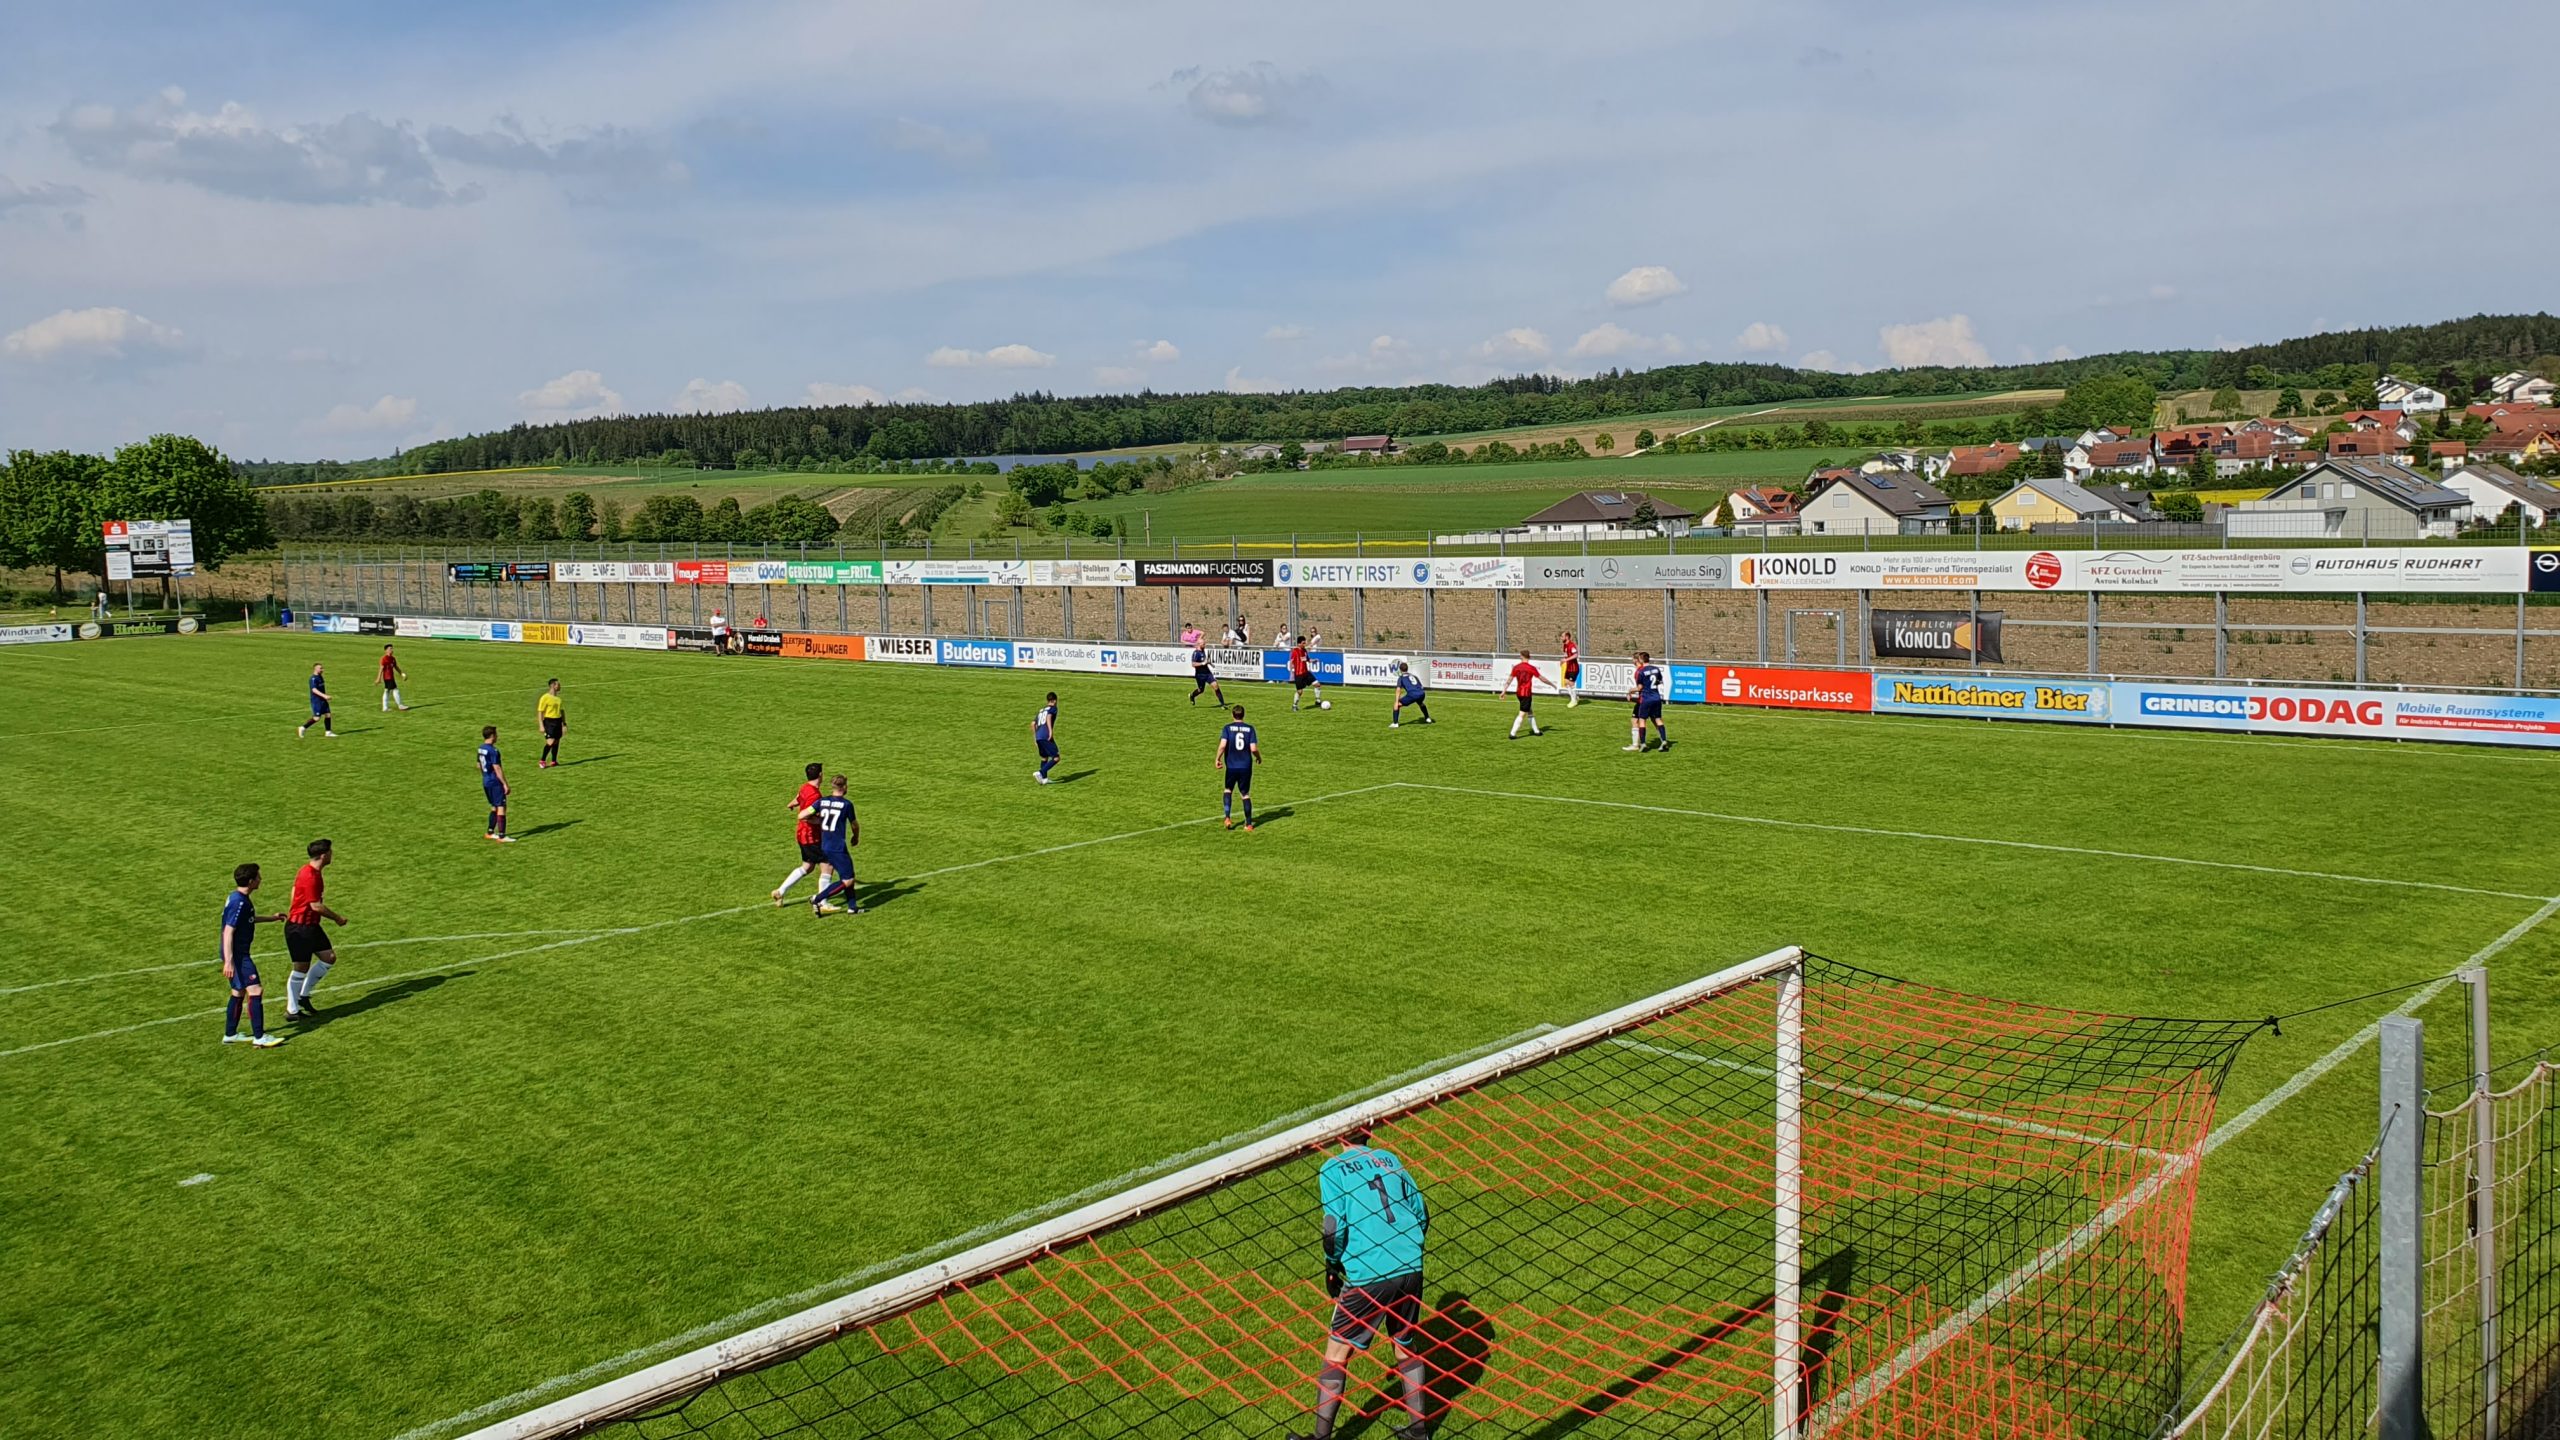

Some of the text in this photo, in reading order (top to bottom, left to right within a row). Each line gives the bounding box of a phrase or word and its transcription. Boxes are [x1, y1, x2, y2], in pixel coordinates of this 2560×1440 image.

[1943, 556, 1976, 564] Erfahrung
[2181, 553, 2280, 562] KFZ-Sachverständigenbüro
[2315, 559, 2483, 569] AUTOHAUS RUDHART
[628, 564, 667, 576] LINDEL BAU
[788, 561, 833, 579] GERÜSTBAU
[850, 565, 872, 578] FRITZ
[1143, 563, 1264, 575] FASZINATION FUGENLOS
[1554, 567, 1584, 578] smart
[1654, 565, 1722, 579] Autohaus Sing
[1759, 557, 1836, 575] KONOLD
[1850, 565, 1881, 573] KONOLD
[1888, 565, 1899, 573] Ihr
[1901, 565, 1933, 573] Furnier-
[1934, 565, 1949, 573] und
[1952, 565, 2013, 574] Türenspezialist
[2091, 566, 2110, 575] KFZ
[679, 569, 700, 581] mayer
[1302, 565, 1352, 582] SAFETY
[1885, 575, 1974, 584] www.konold.com
[1895, 619, 1952, 629] NATÜRLICH
[0, 627, 47, 637] Windkraft
[540, 625, 566, 641] SCHILL
[640, 630, 664, 642] RÖSER
[1895, 628, 1951, 649] KONOLD
[805, 638, 848, 655] BULLINGER
[878, 638, 932, 655] WIESER
[943, 642, 1007, 662] Buderus
[1036, 648, 1096, 660] VR-Bank Ostalb eG
[1120, 651, 1186, 664] VR-Bank Ostalb eG
[1207, 648, 1261, 666] KLINGENMAIER
[1326, 663, 1342, 674] ODR
[1431, 659, 1491, 670] Sonnenschutz
[1437, 671, 1484, 681] & Rollladen
[1649, 675, 1657, 690] 2
[1748, 685, 1854, 704] Kreissparkasse
[1893, 682, 2089, 712] Nattheimer Bier
[2145, 696, 2383, 727] GRINBOLD JODAG
[2396, 702, 2545, 719] Mobile Raumsysteme
[2515, 723, 2546, 731] Projekte
[1235, 732, 1245, 750] 6
[820, 808, 841, 832] 27
[1338, 1157, 1393, 1177] TSG 1899
[1367, 1173, 1396, 1224] 1
